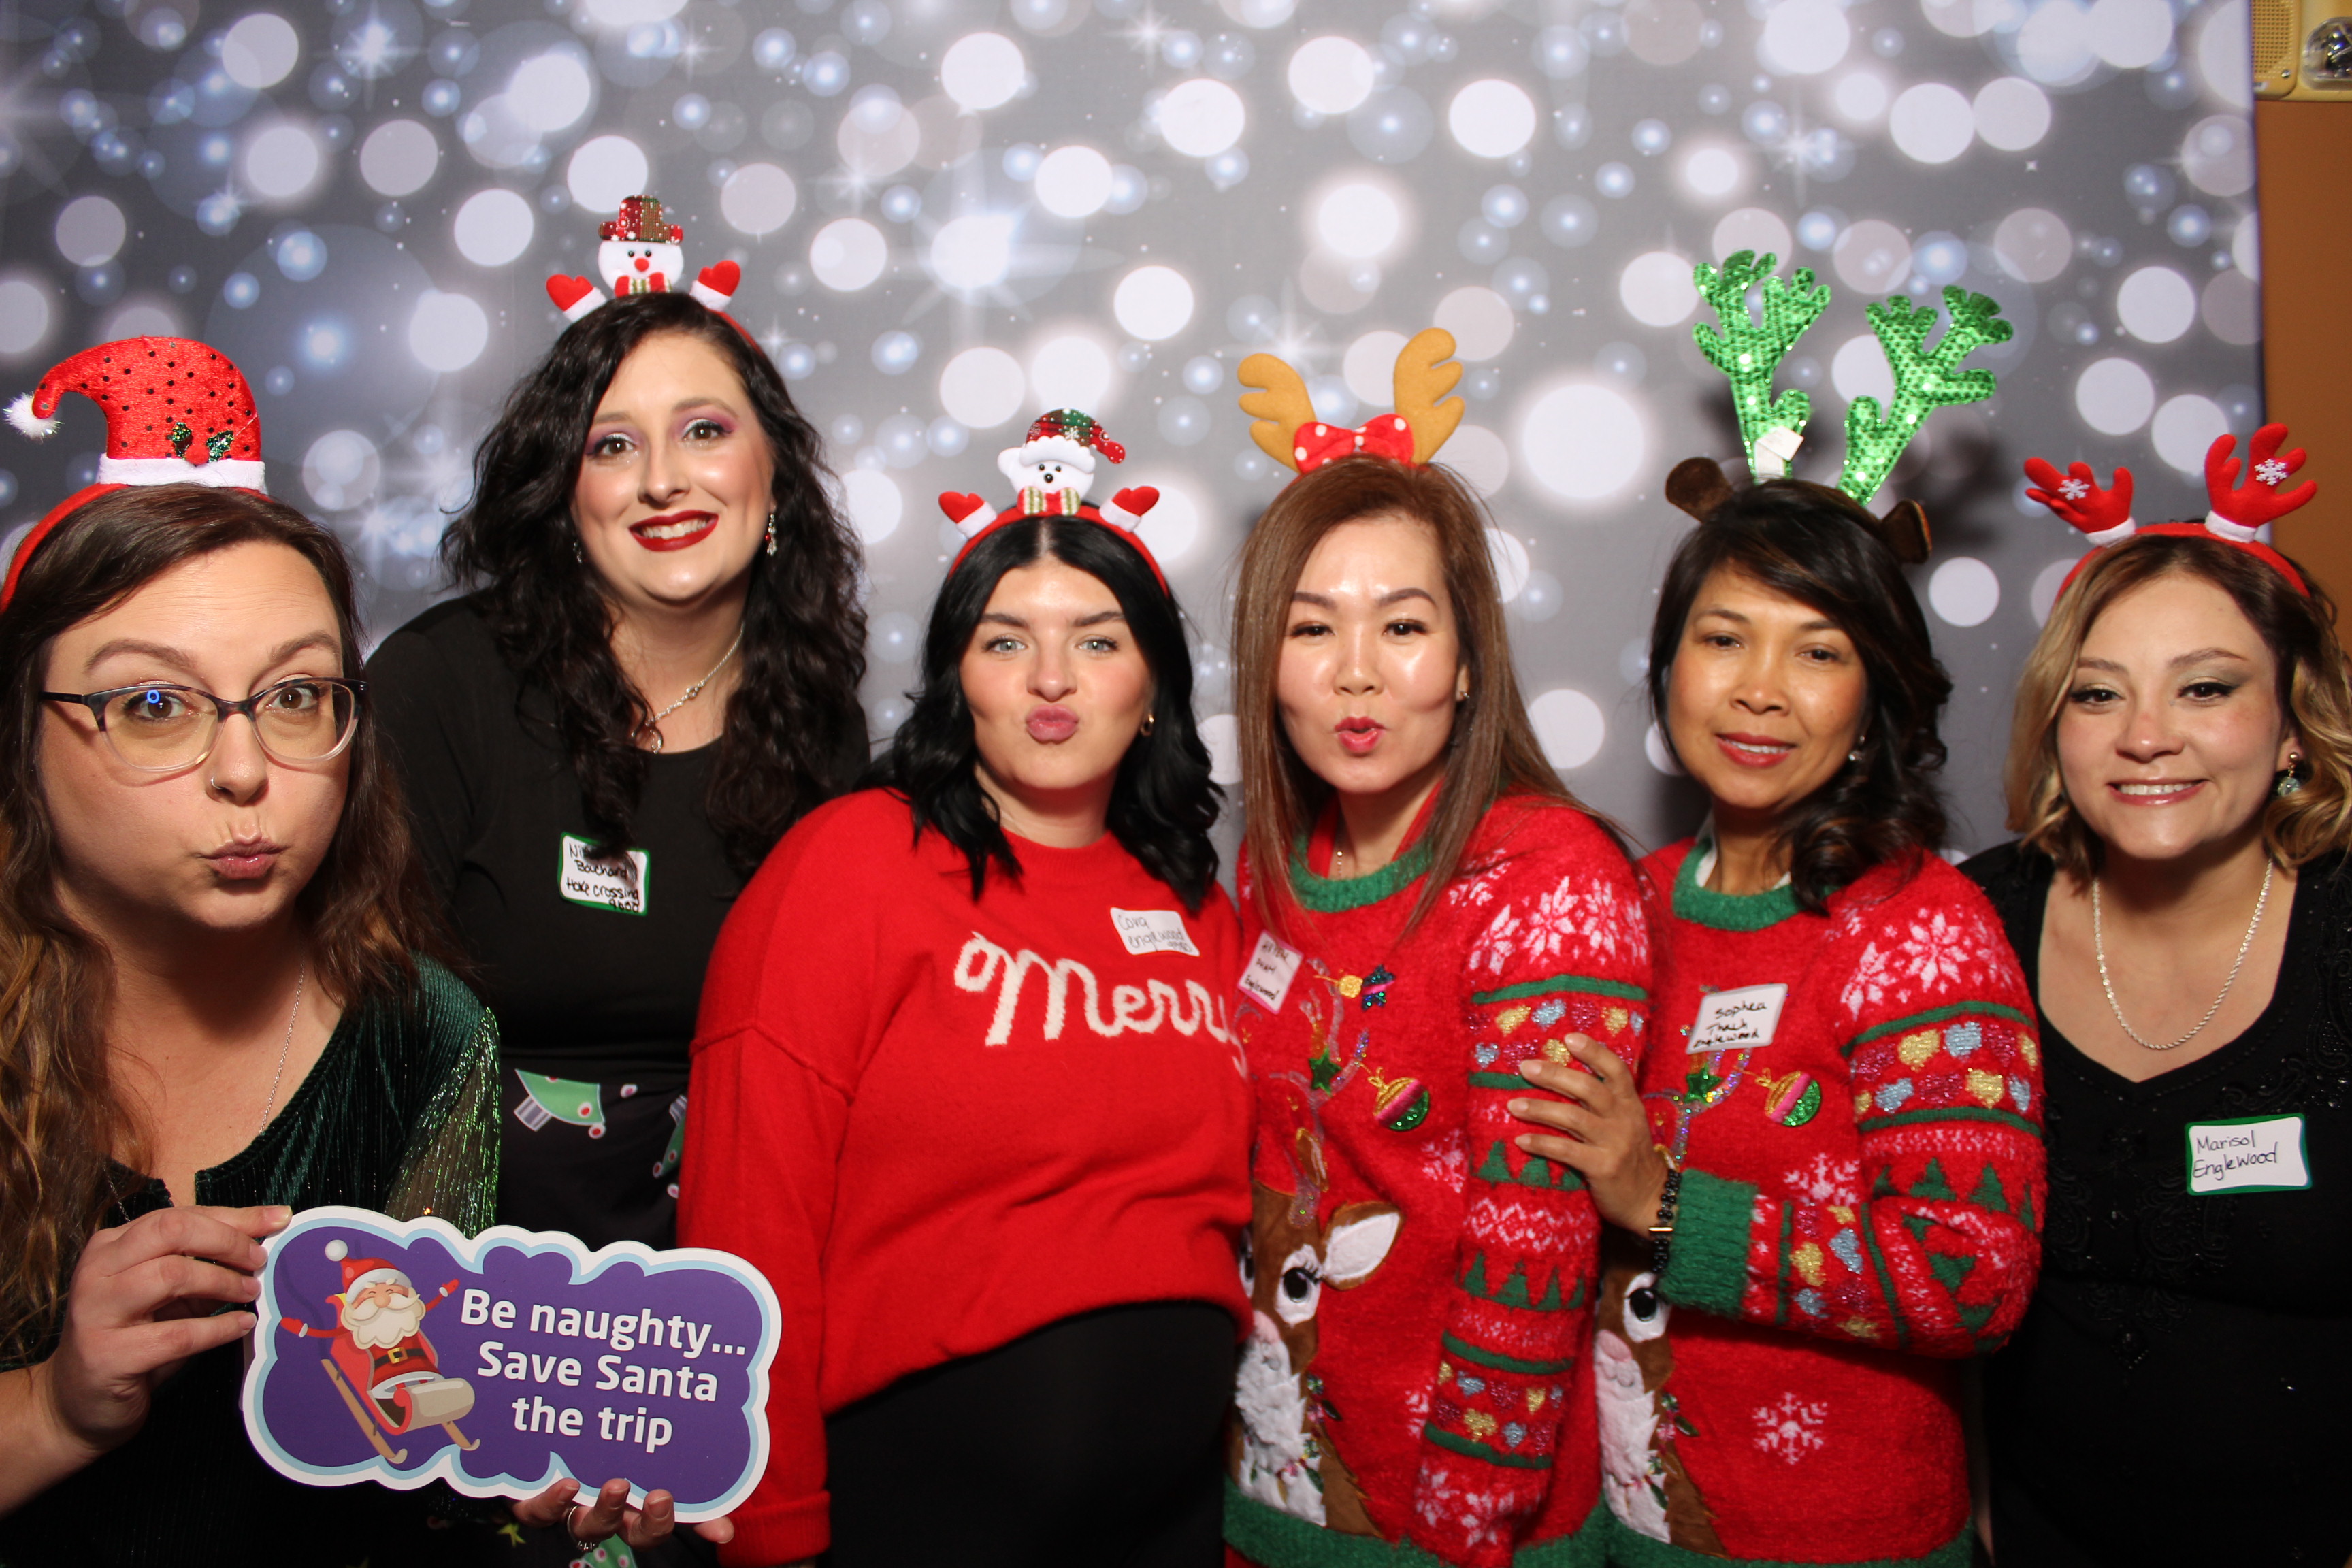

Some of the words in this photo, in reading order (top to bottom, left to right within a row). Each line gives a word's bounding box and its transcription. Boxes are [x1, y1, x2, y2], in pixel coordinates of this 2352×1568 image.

[953, 930, 1249, 1081] Merry
[2195, 1130, 2256, 1154] Marisol
[461, 1288, 517, 1329] Be
[529, 1303, 746, 1359] naughty...
[477, 1341, 583, 1387] Save
[595, 1354, 719, 1402] Santa
[511, 1395, 584, 1437] the
[598, 1406, 673, 1454] trip
